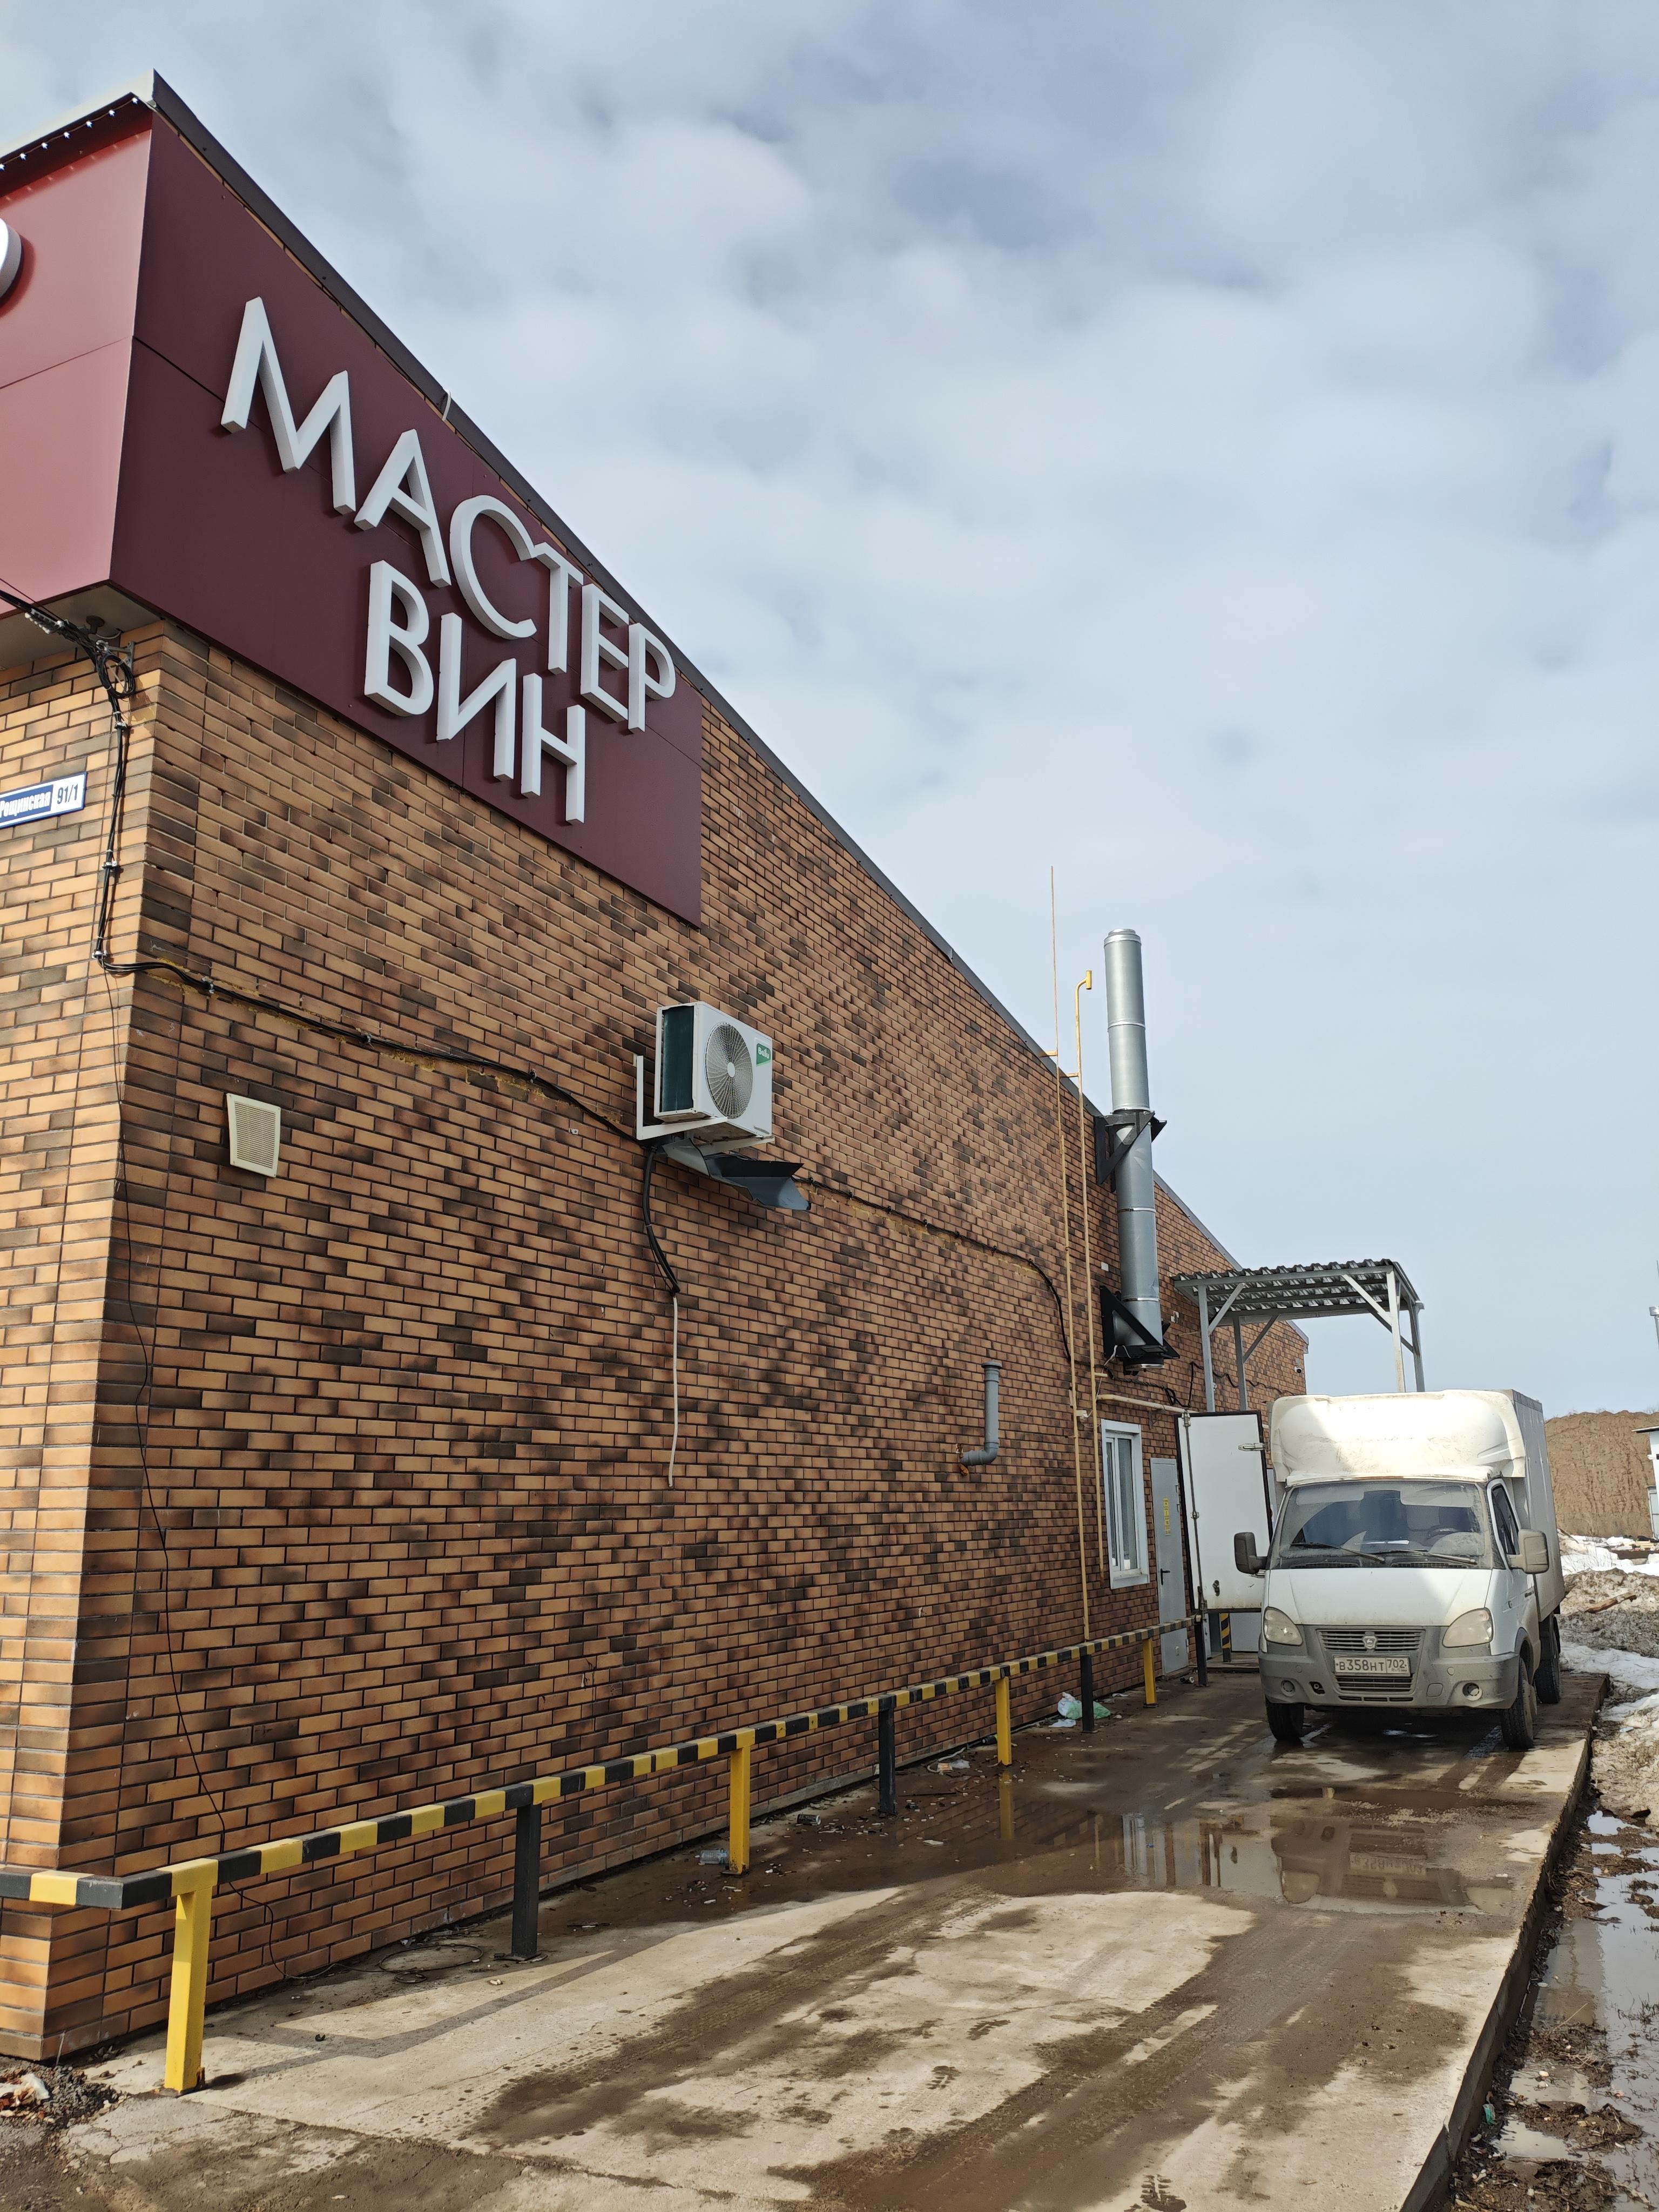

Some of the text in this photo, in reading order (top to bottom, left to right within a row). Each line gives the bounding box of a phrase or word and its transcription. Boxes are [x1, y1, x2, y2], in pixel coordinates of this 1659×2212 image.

[220, 296, 676, 733] МАСТЕР
[57, 784, 78, 804] 91/1
[364, 560, 585, 824] ВИН
